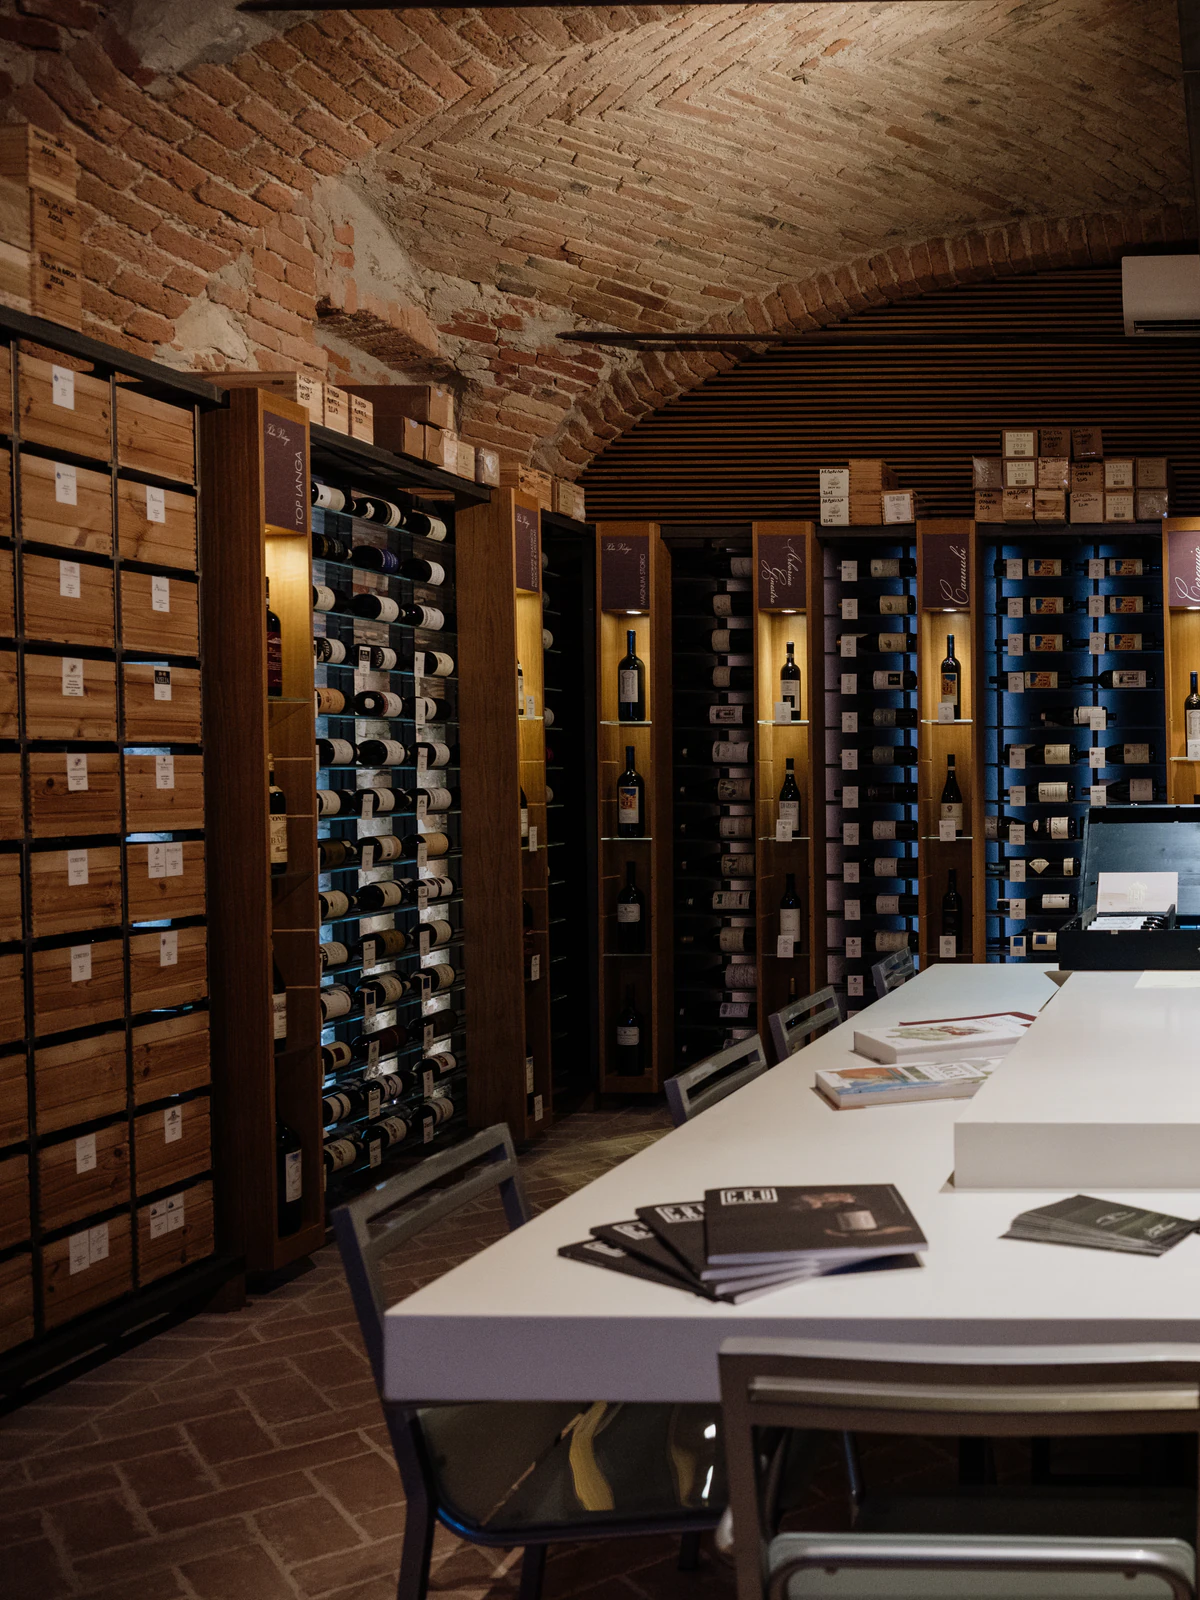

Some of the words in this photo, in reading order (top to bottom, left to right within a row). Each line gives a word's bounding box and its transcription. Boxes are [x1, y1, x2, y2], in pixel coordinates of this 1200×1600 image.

[295, 451, 304, 497] LANGA
[295, 499, 304, 526] TOP
[760, 559, 787, 604] Ginestra
[783, 538, 803, 587] Arborina
[939, 545, 970, 605] Cannubi
[724, 1188, 776, 1205] C.R.U
